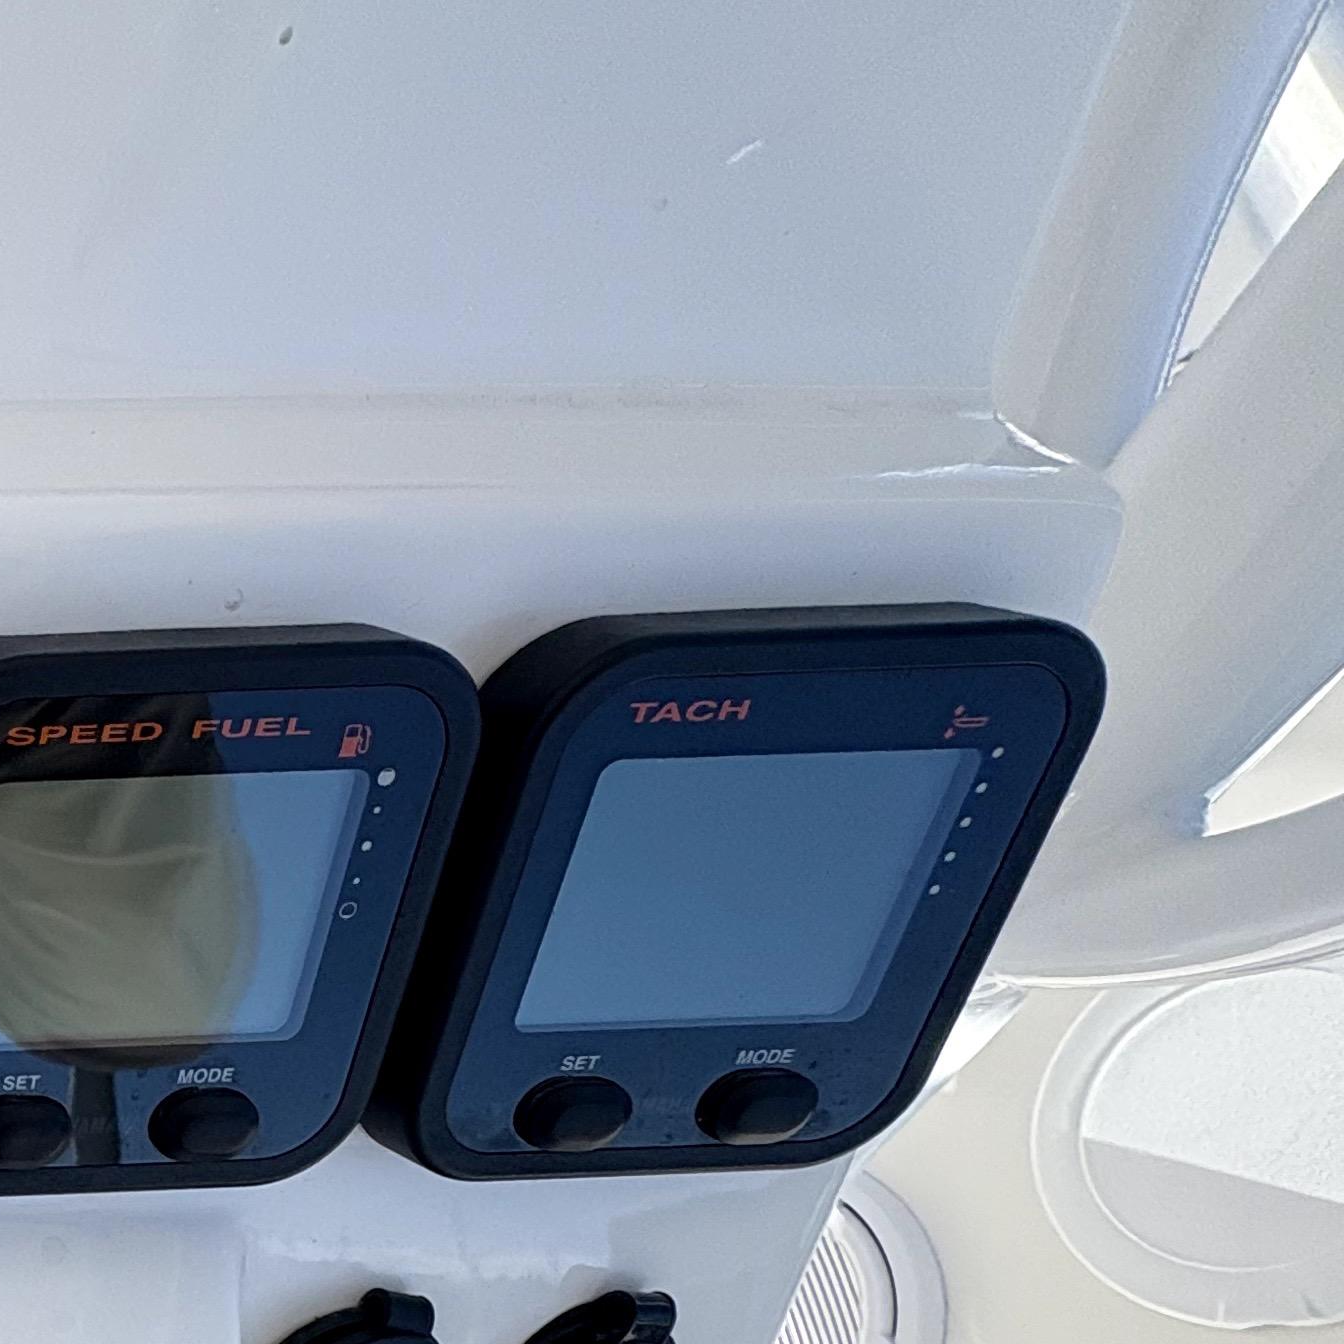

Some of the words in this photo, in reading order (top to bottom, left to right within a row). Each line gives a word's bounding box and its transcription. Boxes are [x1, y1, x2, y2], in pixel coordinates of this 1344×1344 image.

[629, 699, 751, 723] TACH
[6, 722, 163, 746] SPEED
[192, 717, 311, 741] FUEL
[561, 1056, 600, 1070] SET
[736, 1049, 795, 1064] MODE
[3, 1075, 40, 1090] SET
[177, 1068, 234, 1083] MODE
